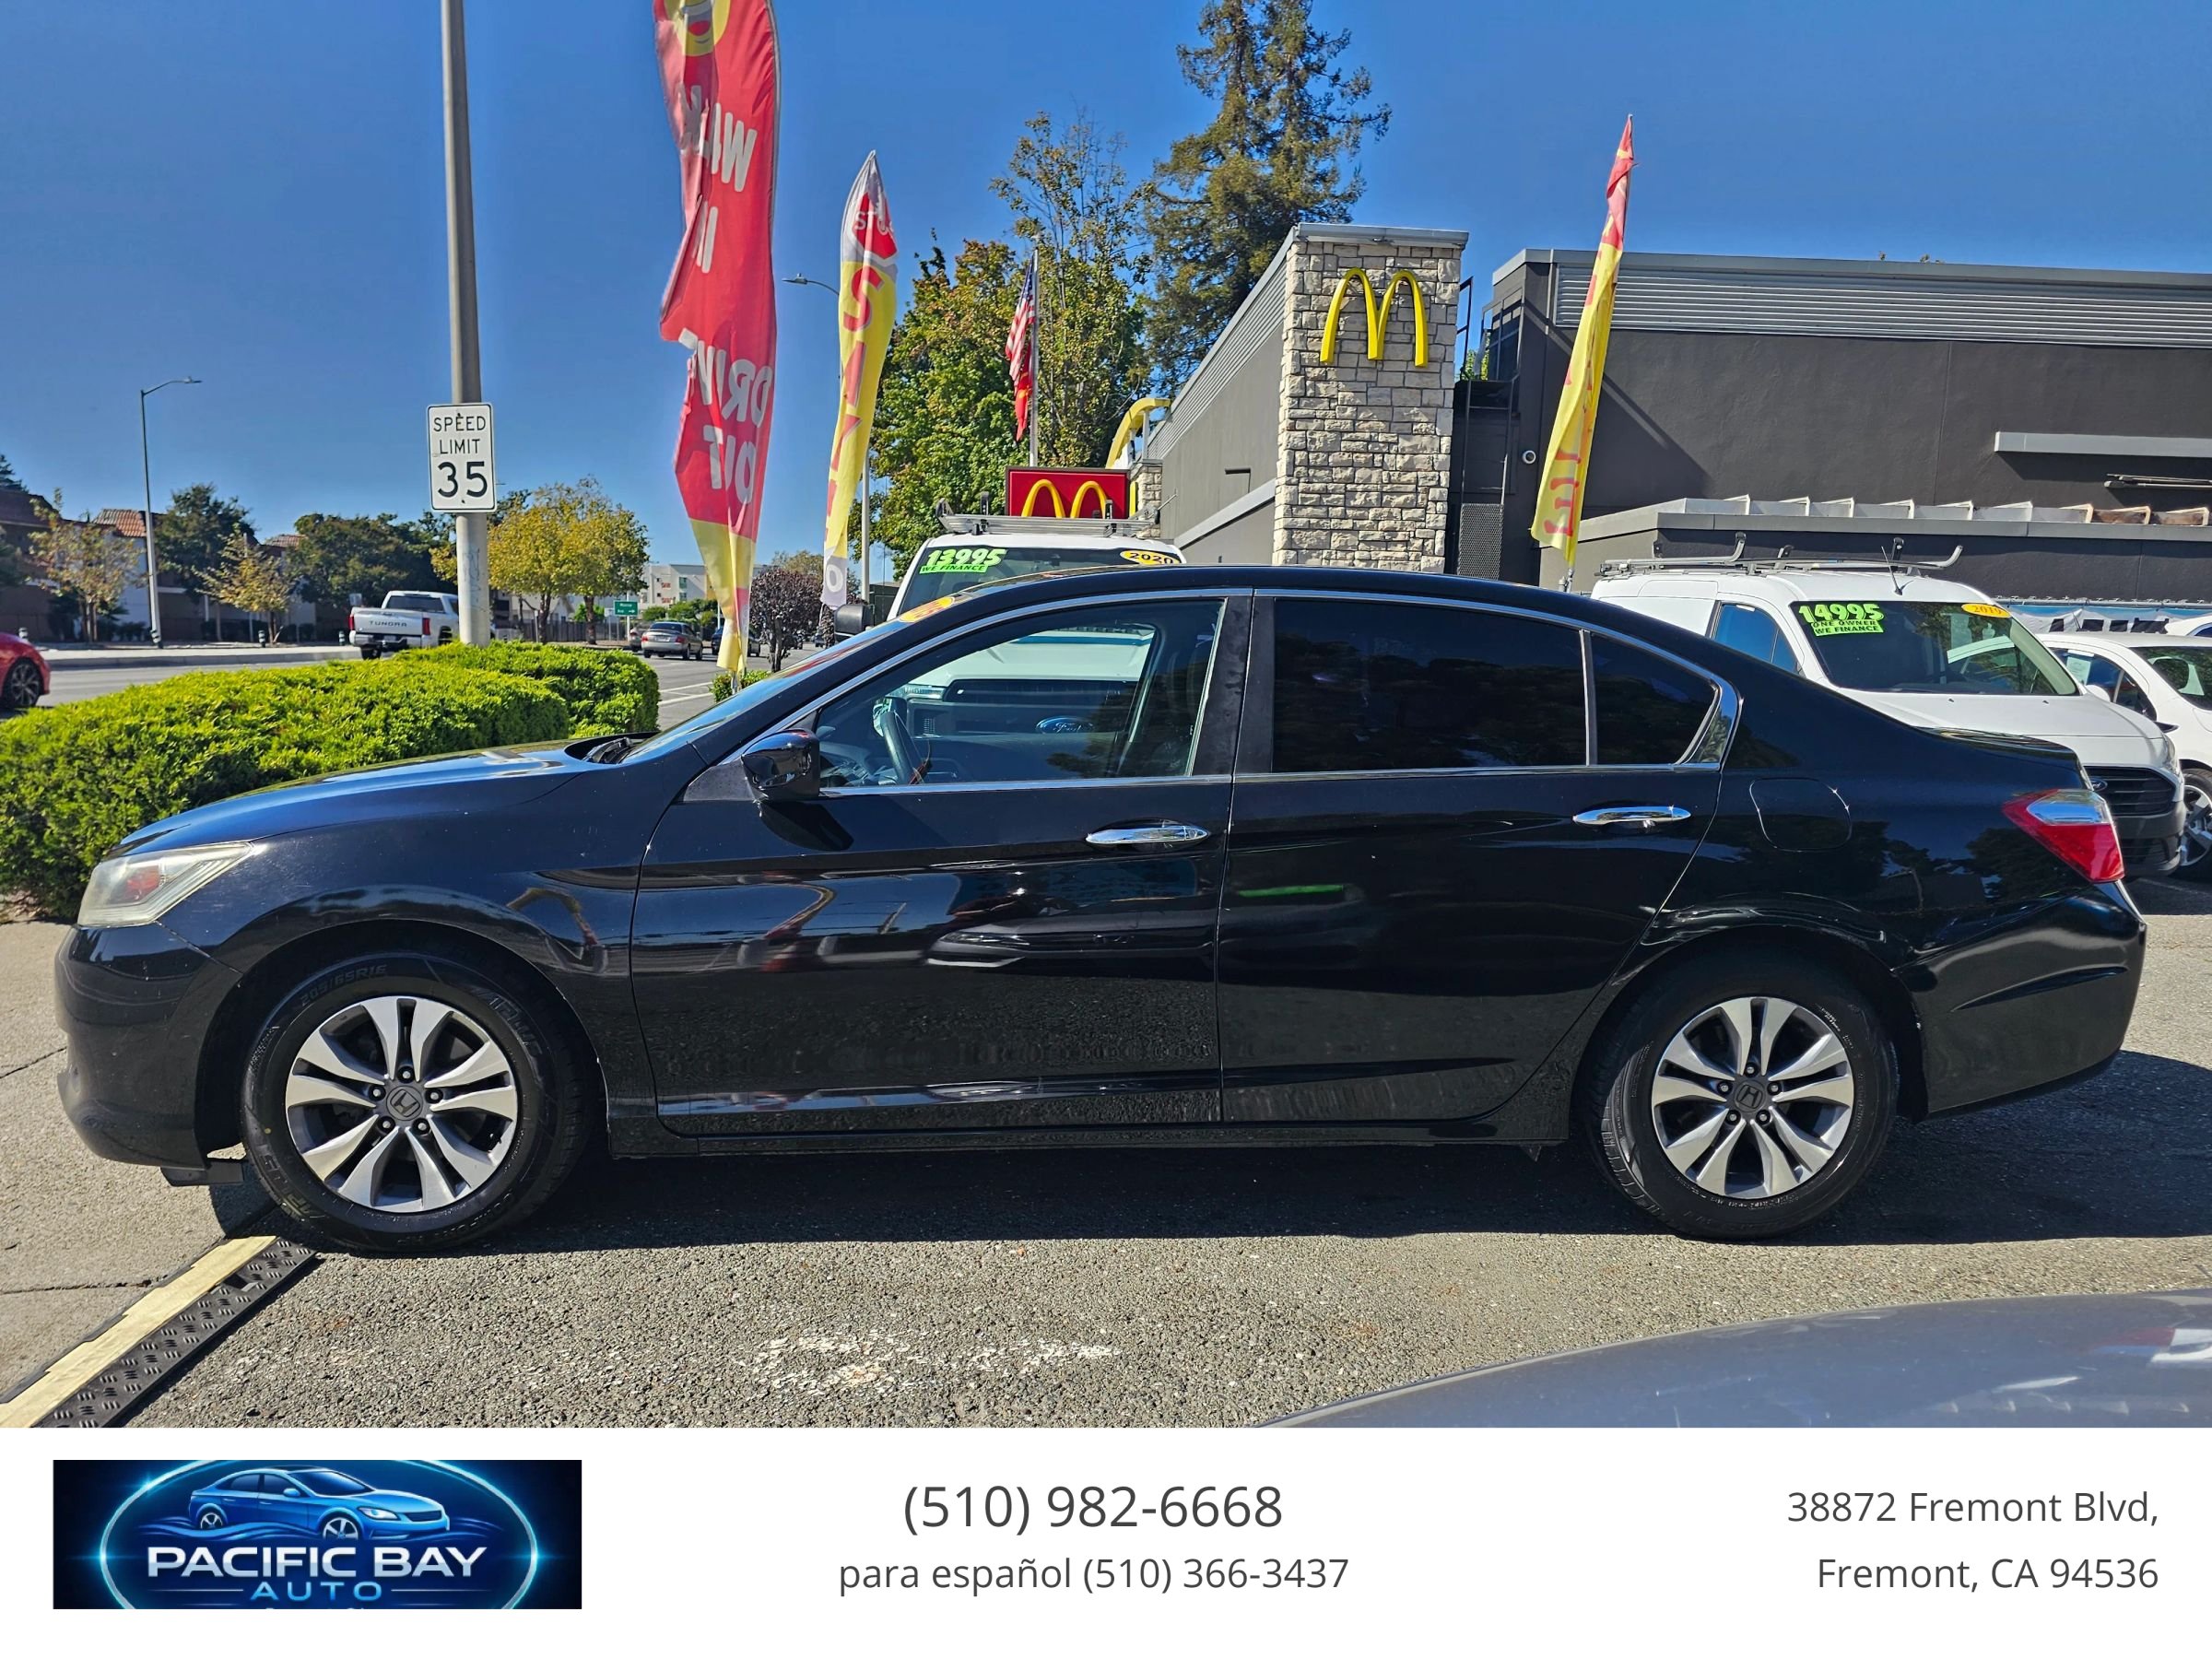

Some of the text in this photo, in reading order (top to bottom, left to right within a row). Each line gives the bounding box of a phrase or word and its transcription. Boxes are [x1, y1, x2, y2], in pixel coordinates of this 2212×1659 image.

[433, 416, 487, 432] SPEED
[439, 438, 481, 454] LIMIT
[438, 461, 488, 499] 35
[926, 548, 1007, 567] 13995
[1129, 552, 1174, 565] 2020
[1798, 603, 1885, 623] 14995
